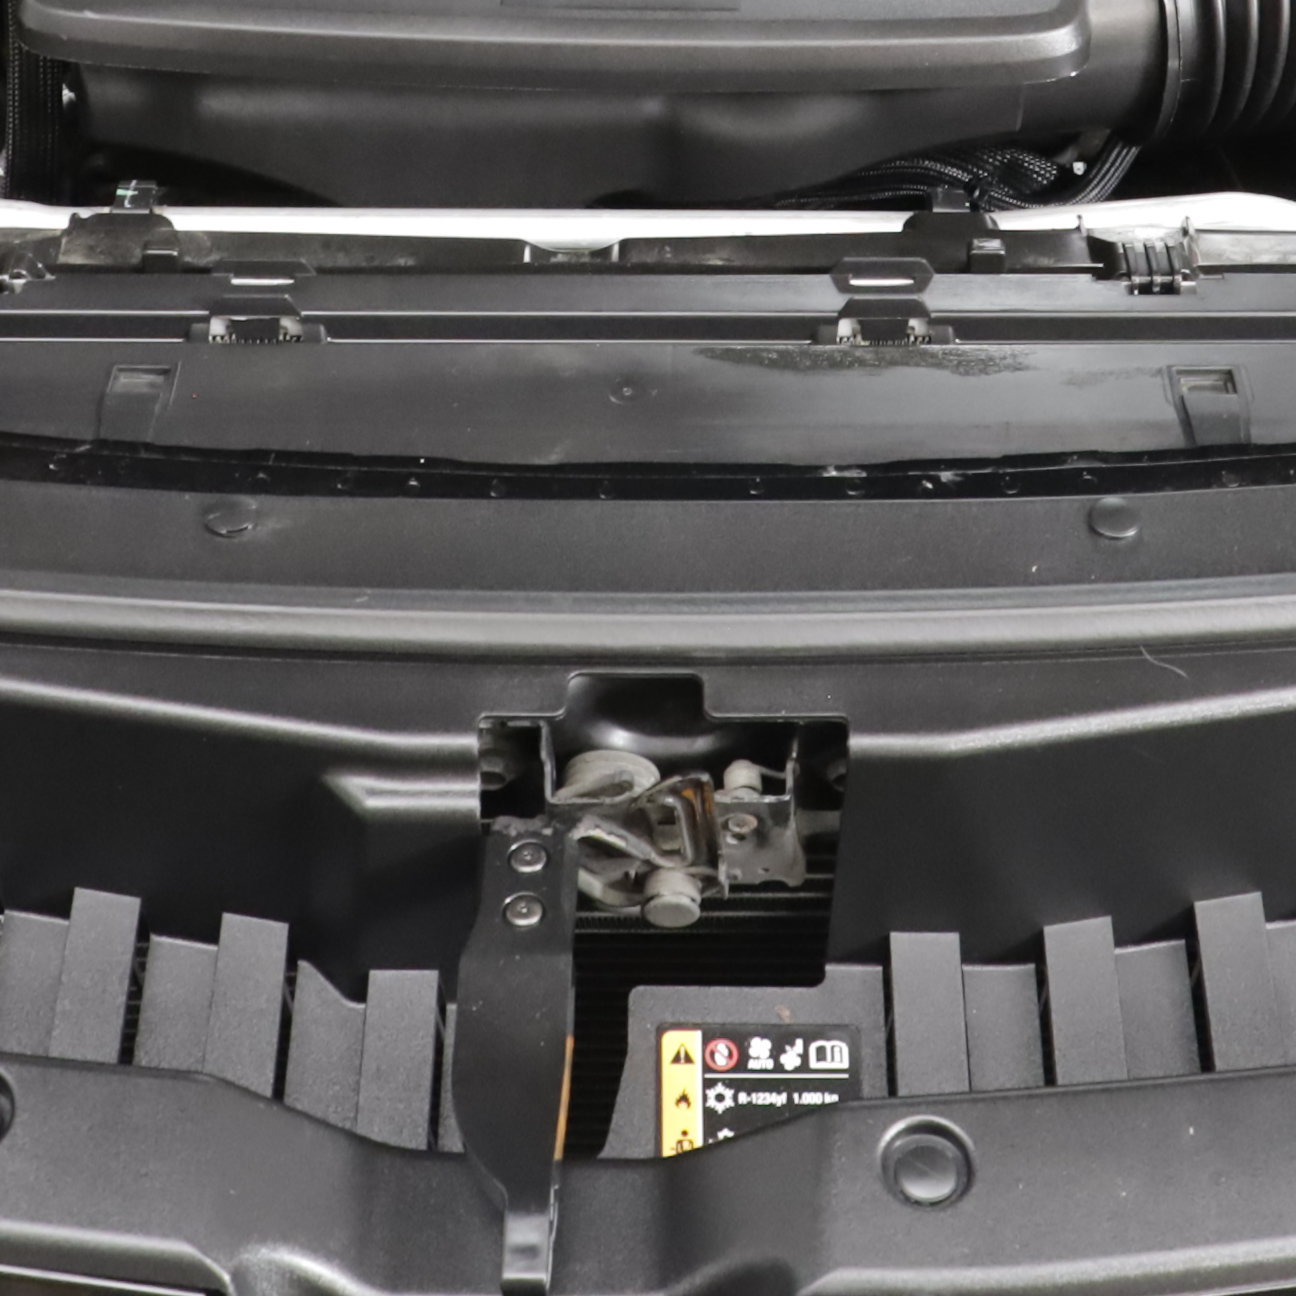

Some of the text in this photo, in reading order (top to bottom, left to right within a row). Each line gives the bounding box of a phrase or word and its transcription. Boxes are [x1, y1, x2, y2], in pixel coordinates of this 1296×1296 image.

[747, 1058, 774, 1070] AUTO
[737, 1091, 787, 1107] R-1234yf
[793, 1092, 822, 1105] 1.000
